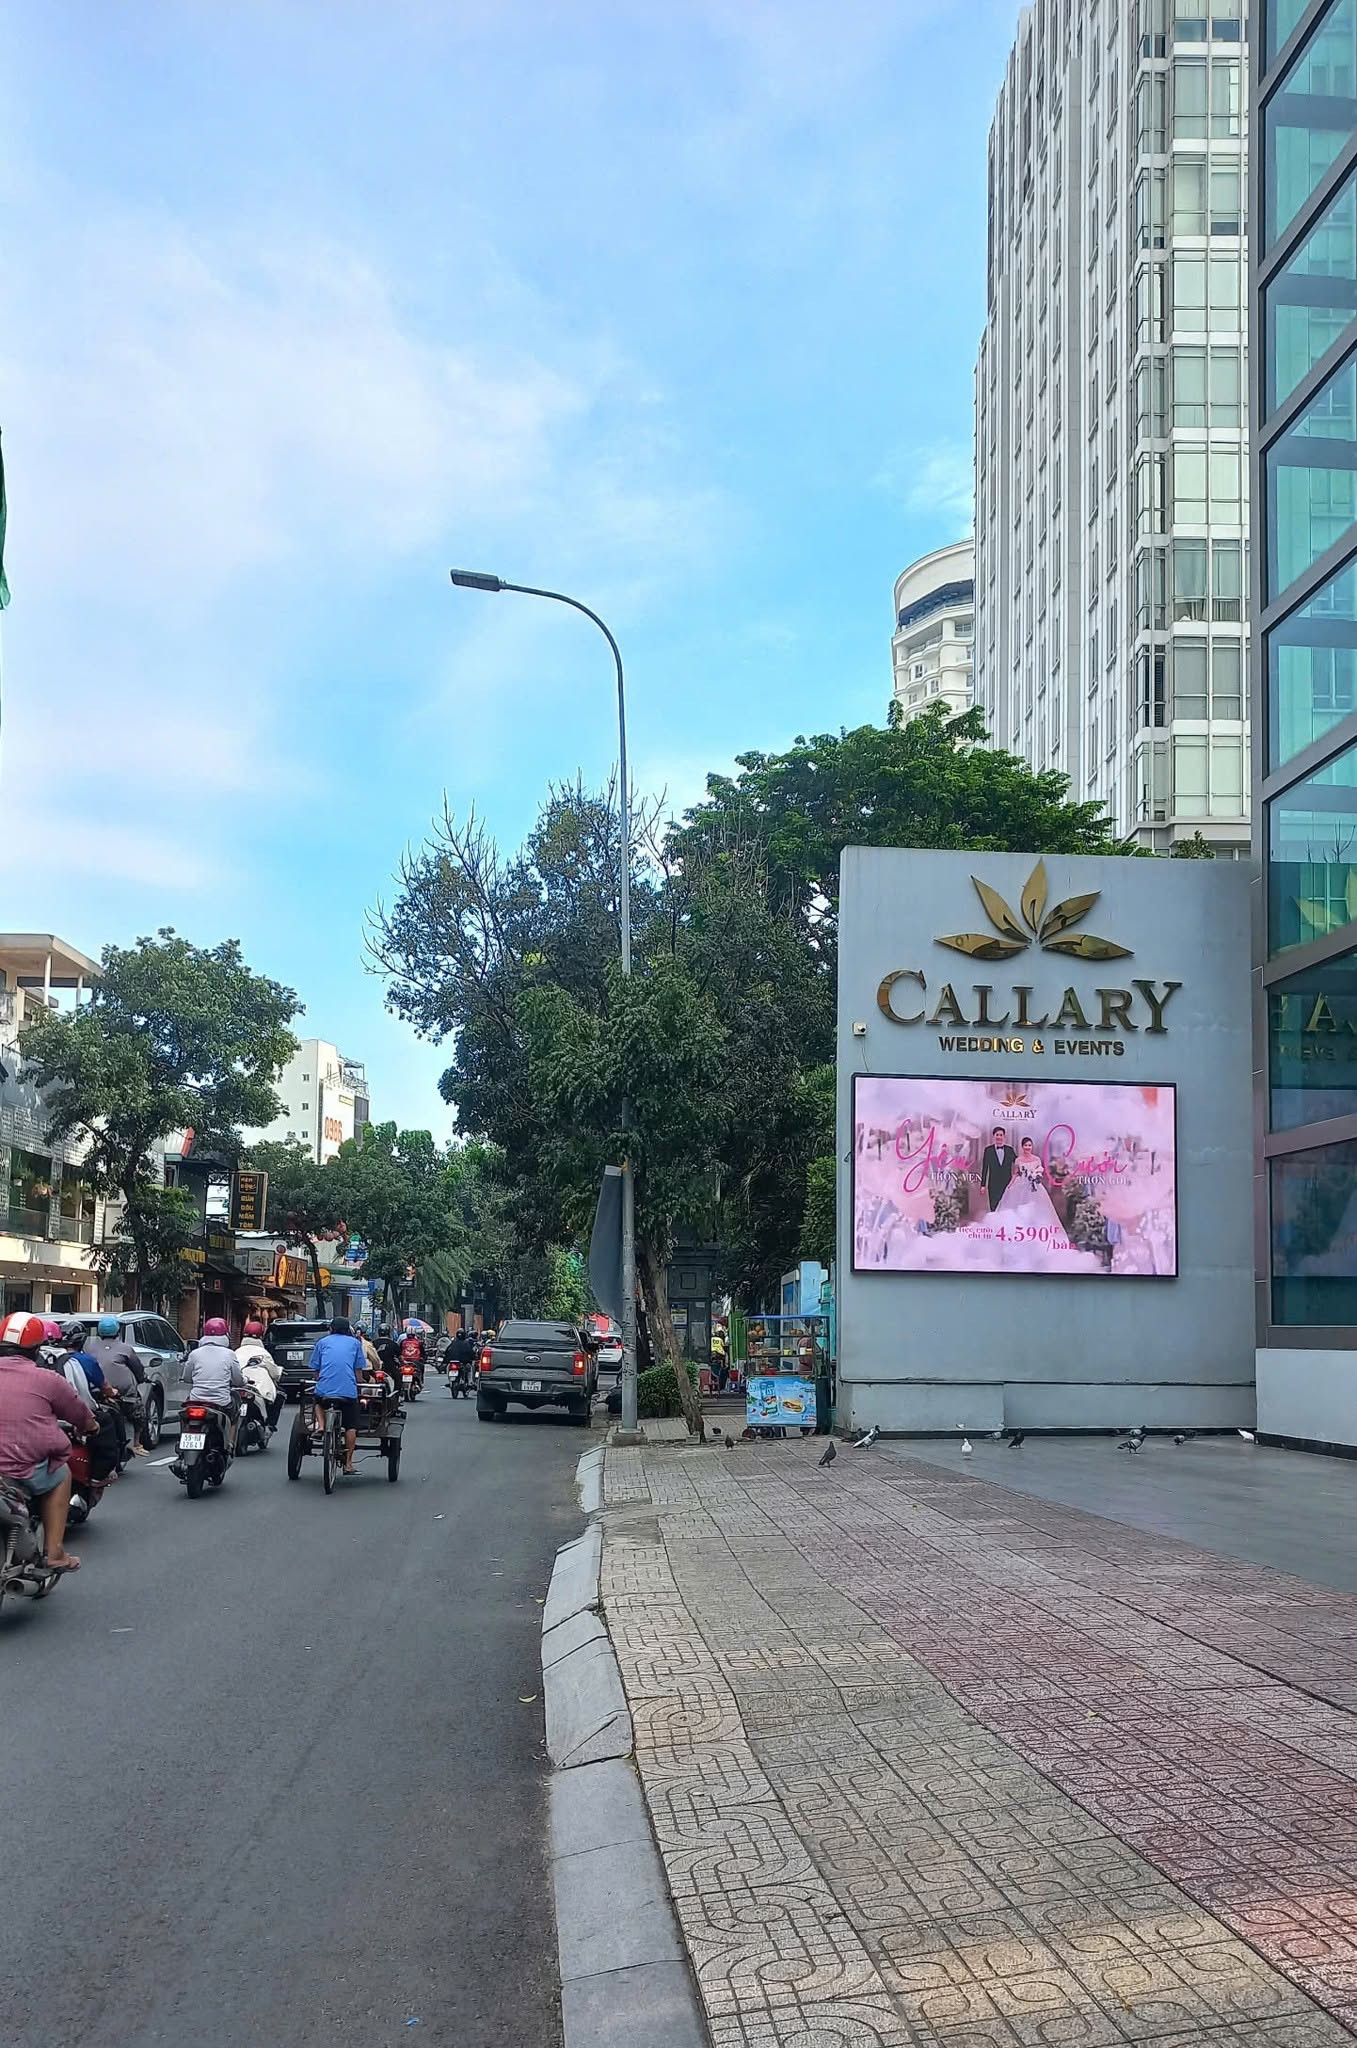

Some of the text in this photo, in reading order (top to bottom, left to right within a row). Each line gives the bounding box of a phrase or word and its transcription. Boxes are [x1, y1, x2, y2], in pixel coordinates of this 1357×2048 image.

[877, 969, 1183, 1033] CALLARY
[938, 1036, 1125, 1056] WEDDING & EVENTS
[992, 1108, 1037, 1119] CALLARY
